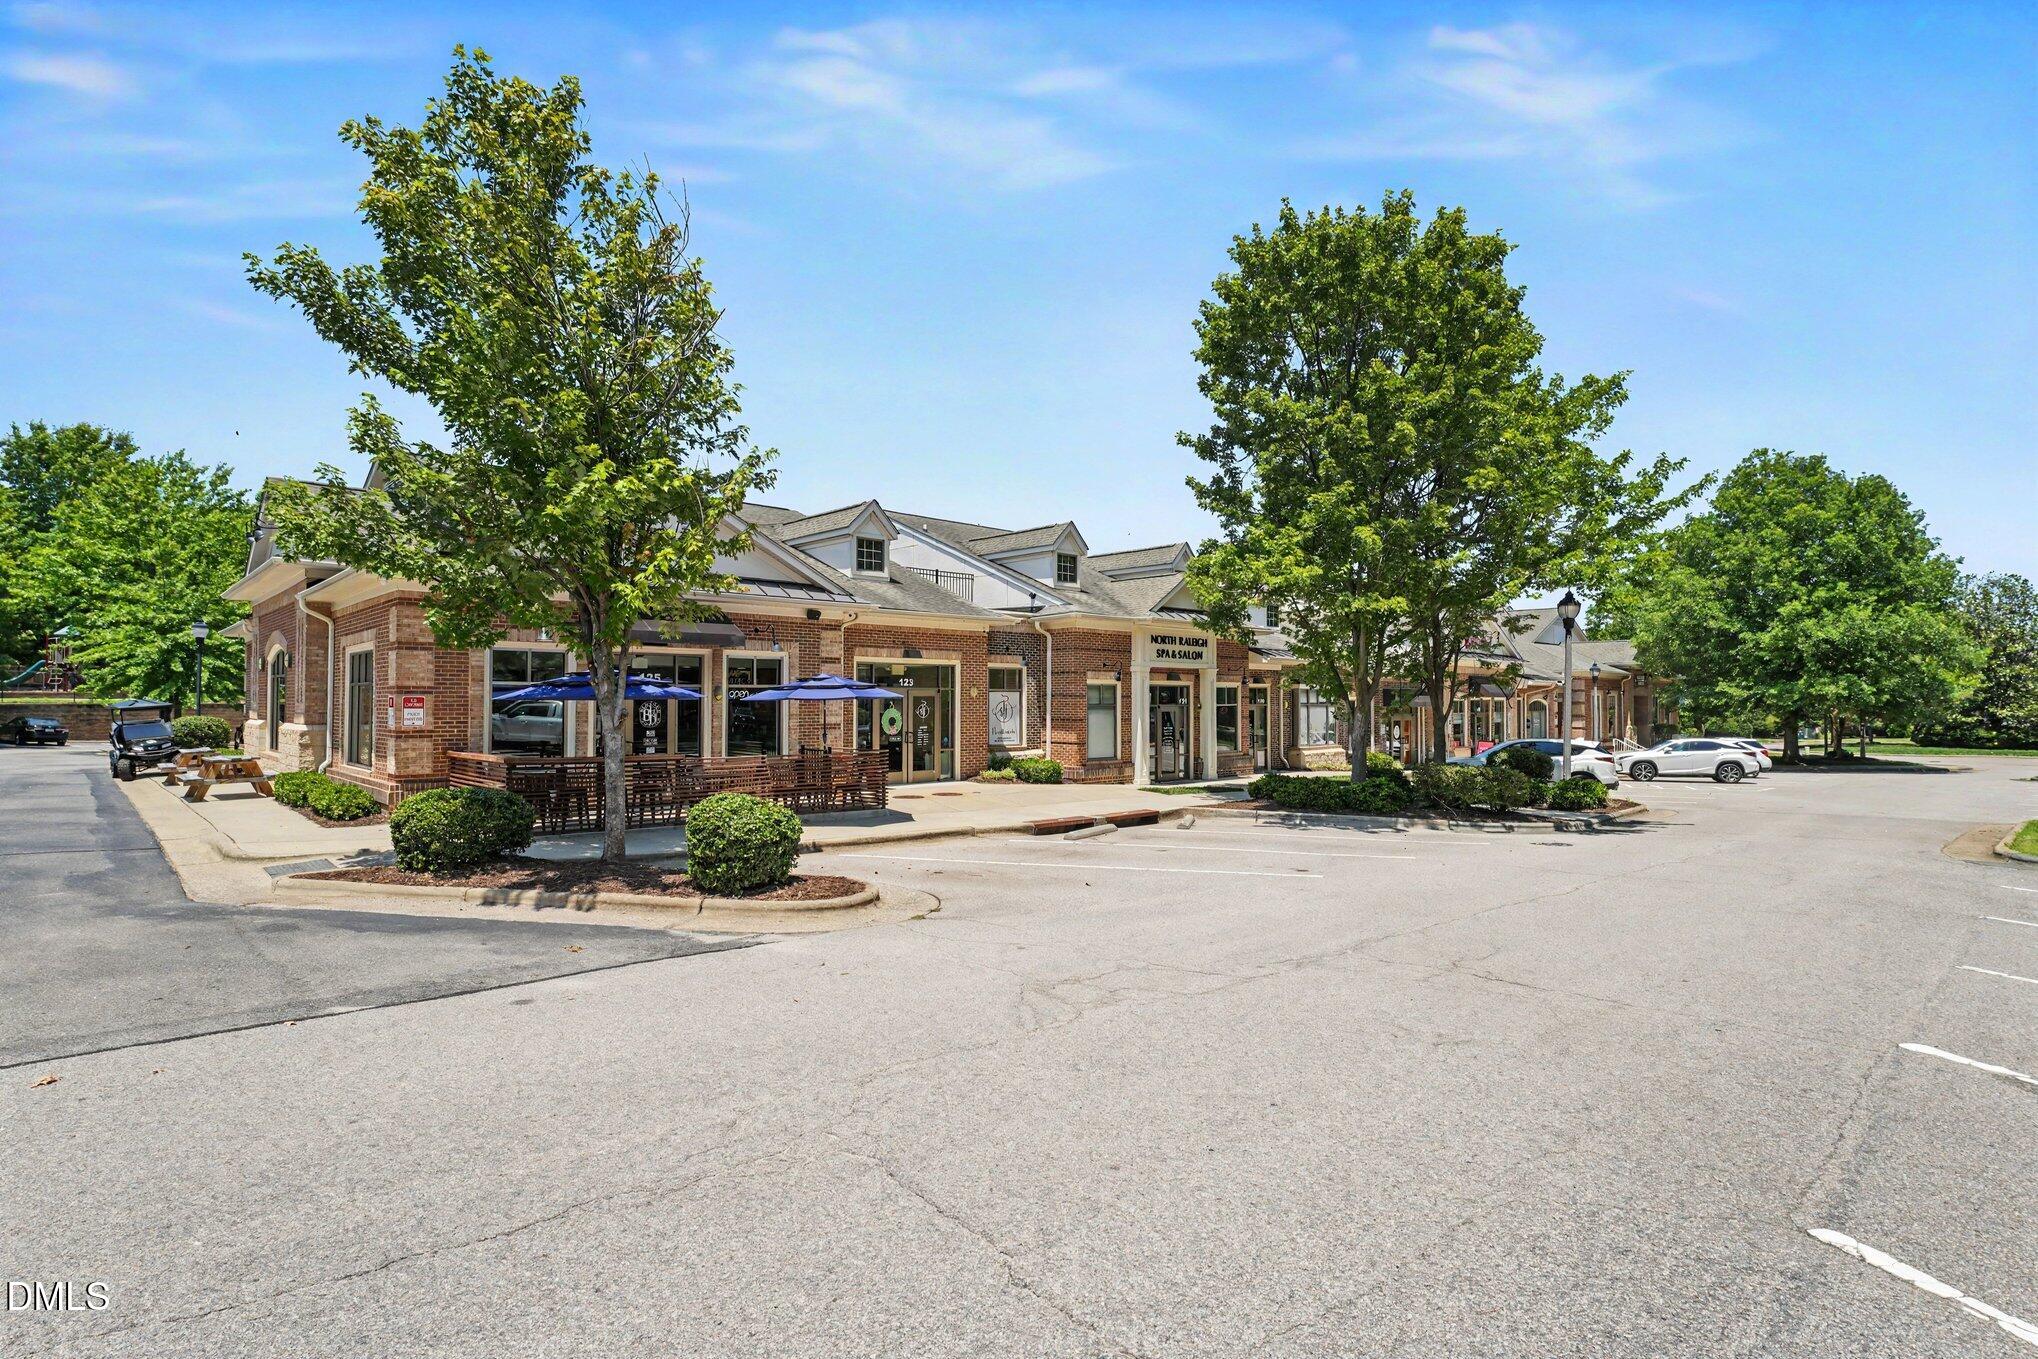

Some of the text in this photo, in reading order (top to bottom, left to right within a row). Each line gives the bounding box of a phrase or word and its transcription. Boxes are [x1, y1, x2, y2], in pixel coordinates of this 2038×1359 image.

[1151, 634, 1207, 647] NORTH RALEIGH
[1156, 648, 1203, 660] SPA & SALON
